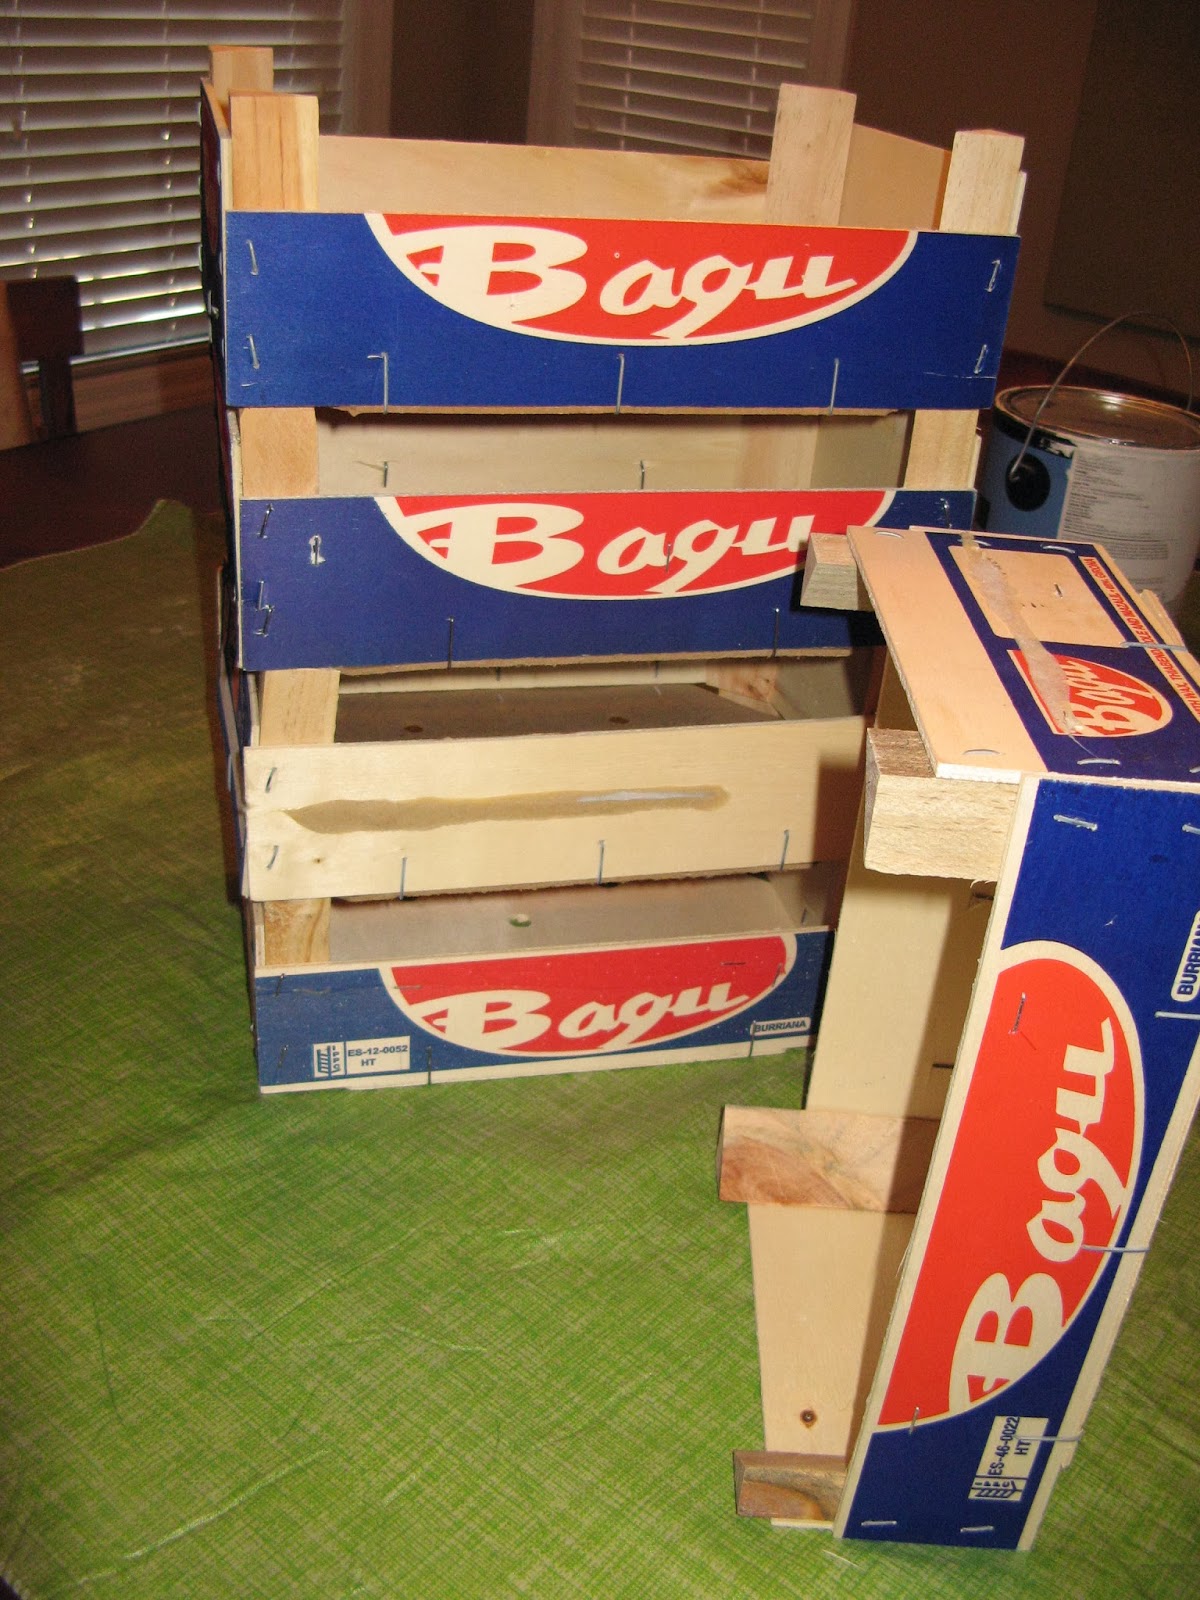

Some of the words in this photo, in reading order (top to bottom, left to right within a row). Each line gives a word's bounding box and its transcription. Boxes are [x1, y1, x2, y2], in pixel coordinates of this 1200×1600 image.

[396, 226, 857, 340] Bagu
[1135, 629, 1183, 680] THIABENDOLE
[412, 981, 750, 1050] Bagu
[754, 1019, 807, 1033] BURRIANA
[347, 1045, 408, 1057] ES-12-0052
[360, 1058, 376, 1067] HT
[949, 1017, 1126, 1416] Bagu
[987, 1416, 1020, 1476] ES-46-0022
[1014, 1439, 1031, 1455] HT
